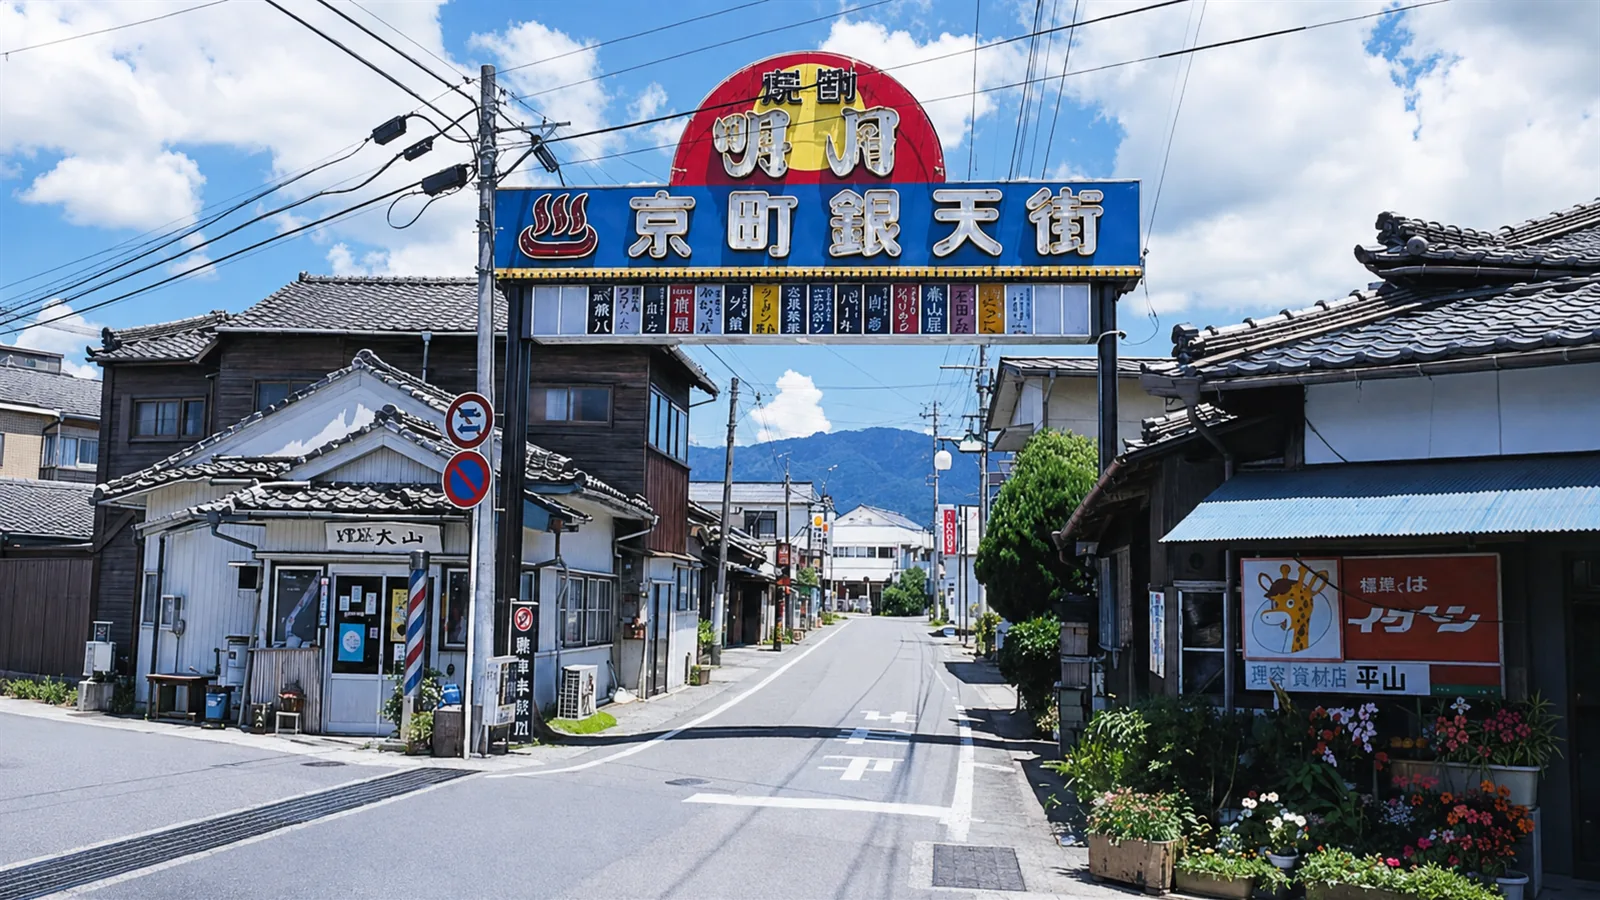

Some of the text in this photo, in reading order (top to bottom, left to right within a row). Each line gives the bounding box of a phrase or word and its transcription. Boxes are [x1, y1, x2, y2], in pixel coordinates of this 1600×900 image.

[628, 188, 1104, 258] 京町銀天街
[1356, 665, 1406, 691] 平山
